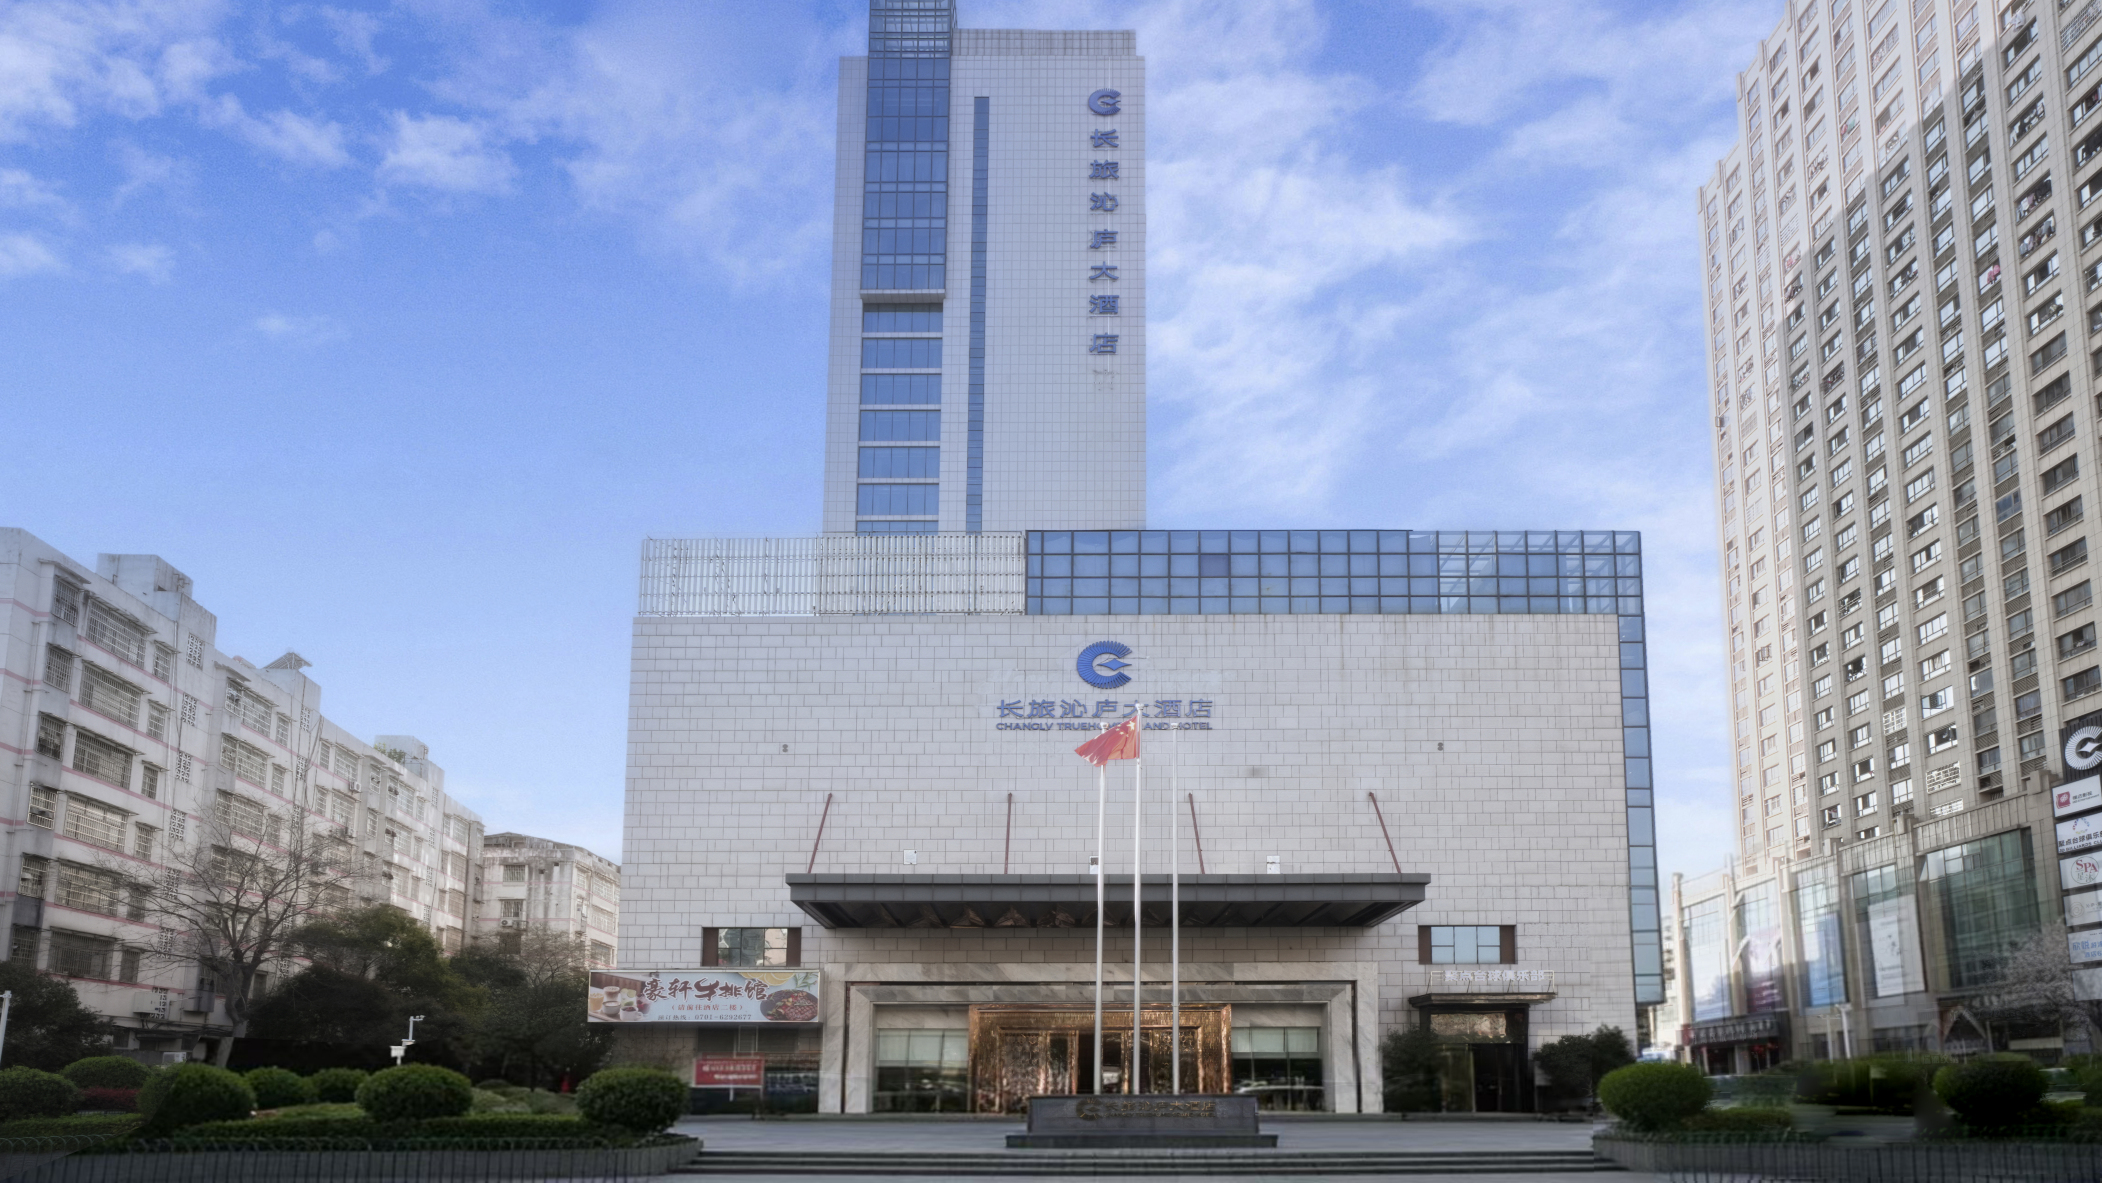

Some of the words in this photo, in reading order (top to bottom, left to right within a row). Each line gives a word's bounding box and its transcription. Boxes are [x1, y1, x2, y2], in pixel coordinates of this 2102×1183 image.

[1089, 128, 1119, 354] 长旅沁庐大酒店
[996, 699, 1213, 718] 长旅沁庐大酒店
[995, 722, 1054, 731] CHANGLV
[2075, 859, 2099, 873] SPA
[1444, 969, 1545, 982] 聚点台球俱乐部
[643, 977, 770, 1002] 豪轩牛排馆
